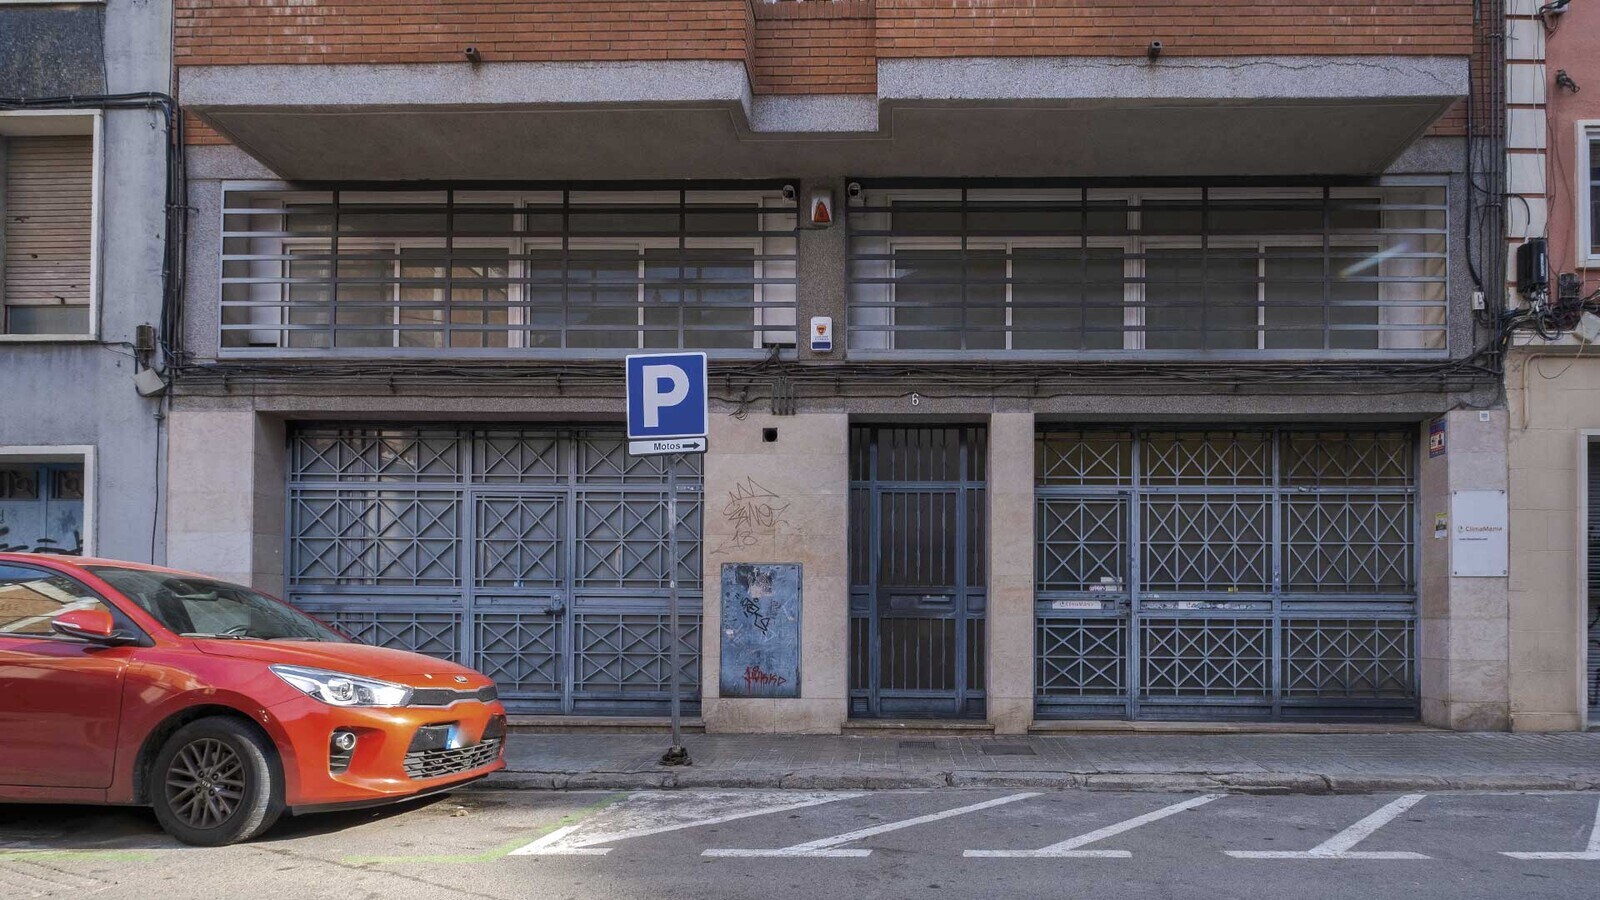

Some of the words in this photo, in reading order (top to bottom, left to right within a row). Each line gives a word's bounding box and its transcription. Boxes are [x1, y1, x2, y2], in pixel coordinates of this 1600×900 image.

[642, 364, 690, 428] P
[911, 392, 919, 406] 6
[653, 442, 681, 451] Motos
